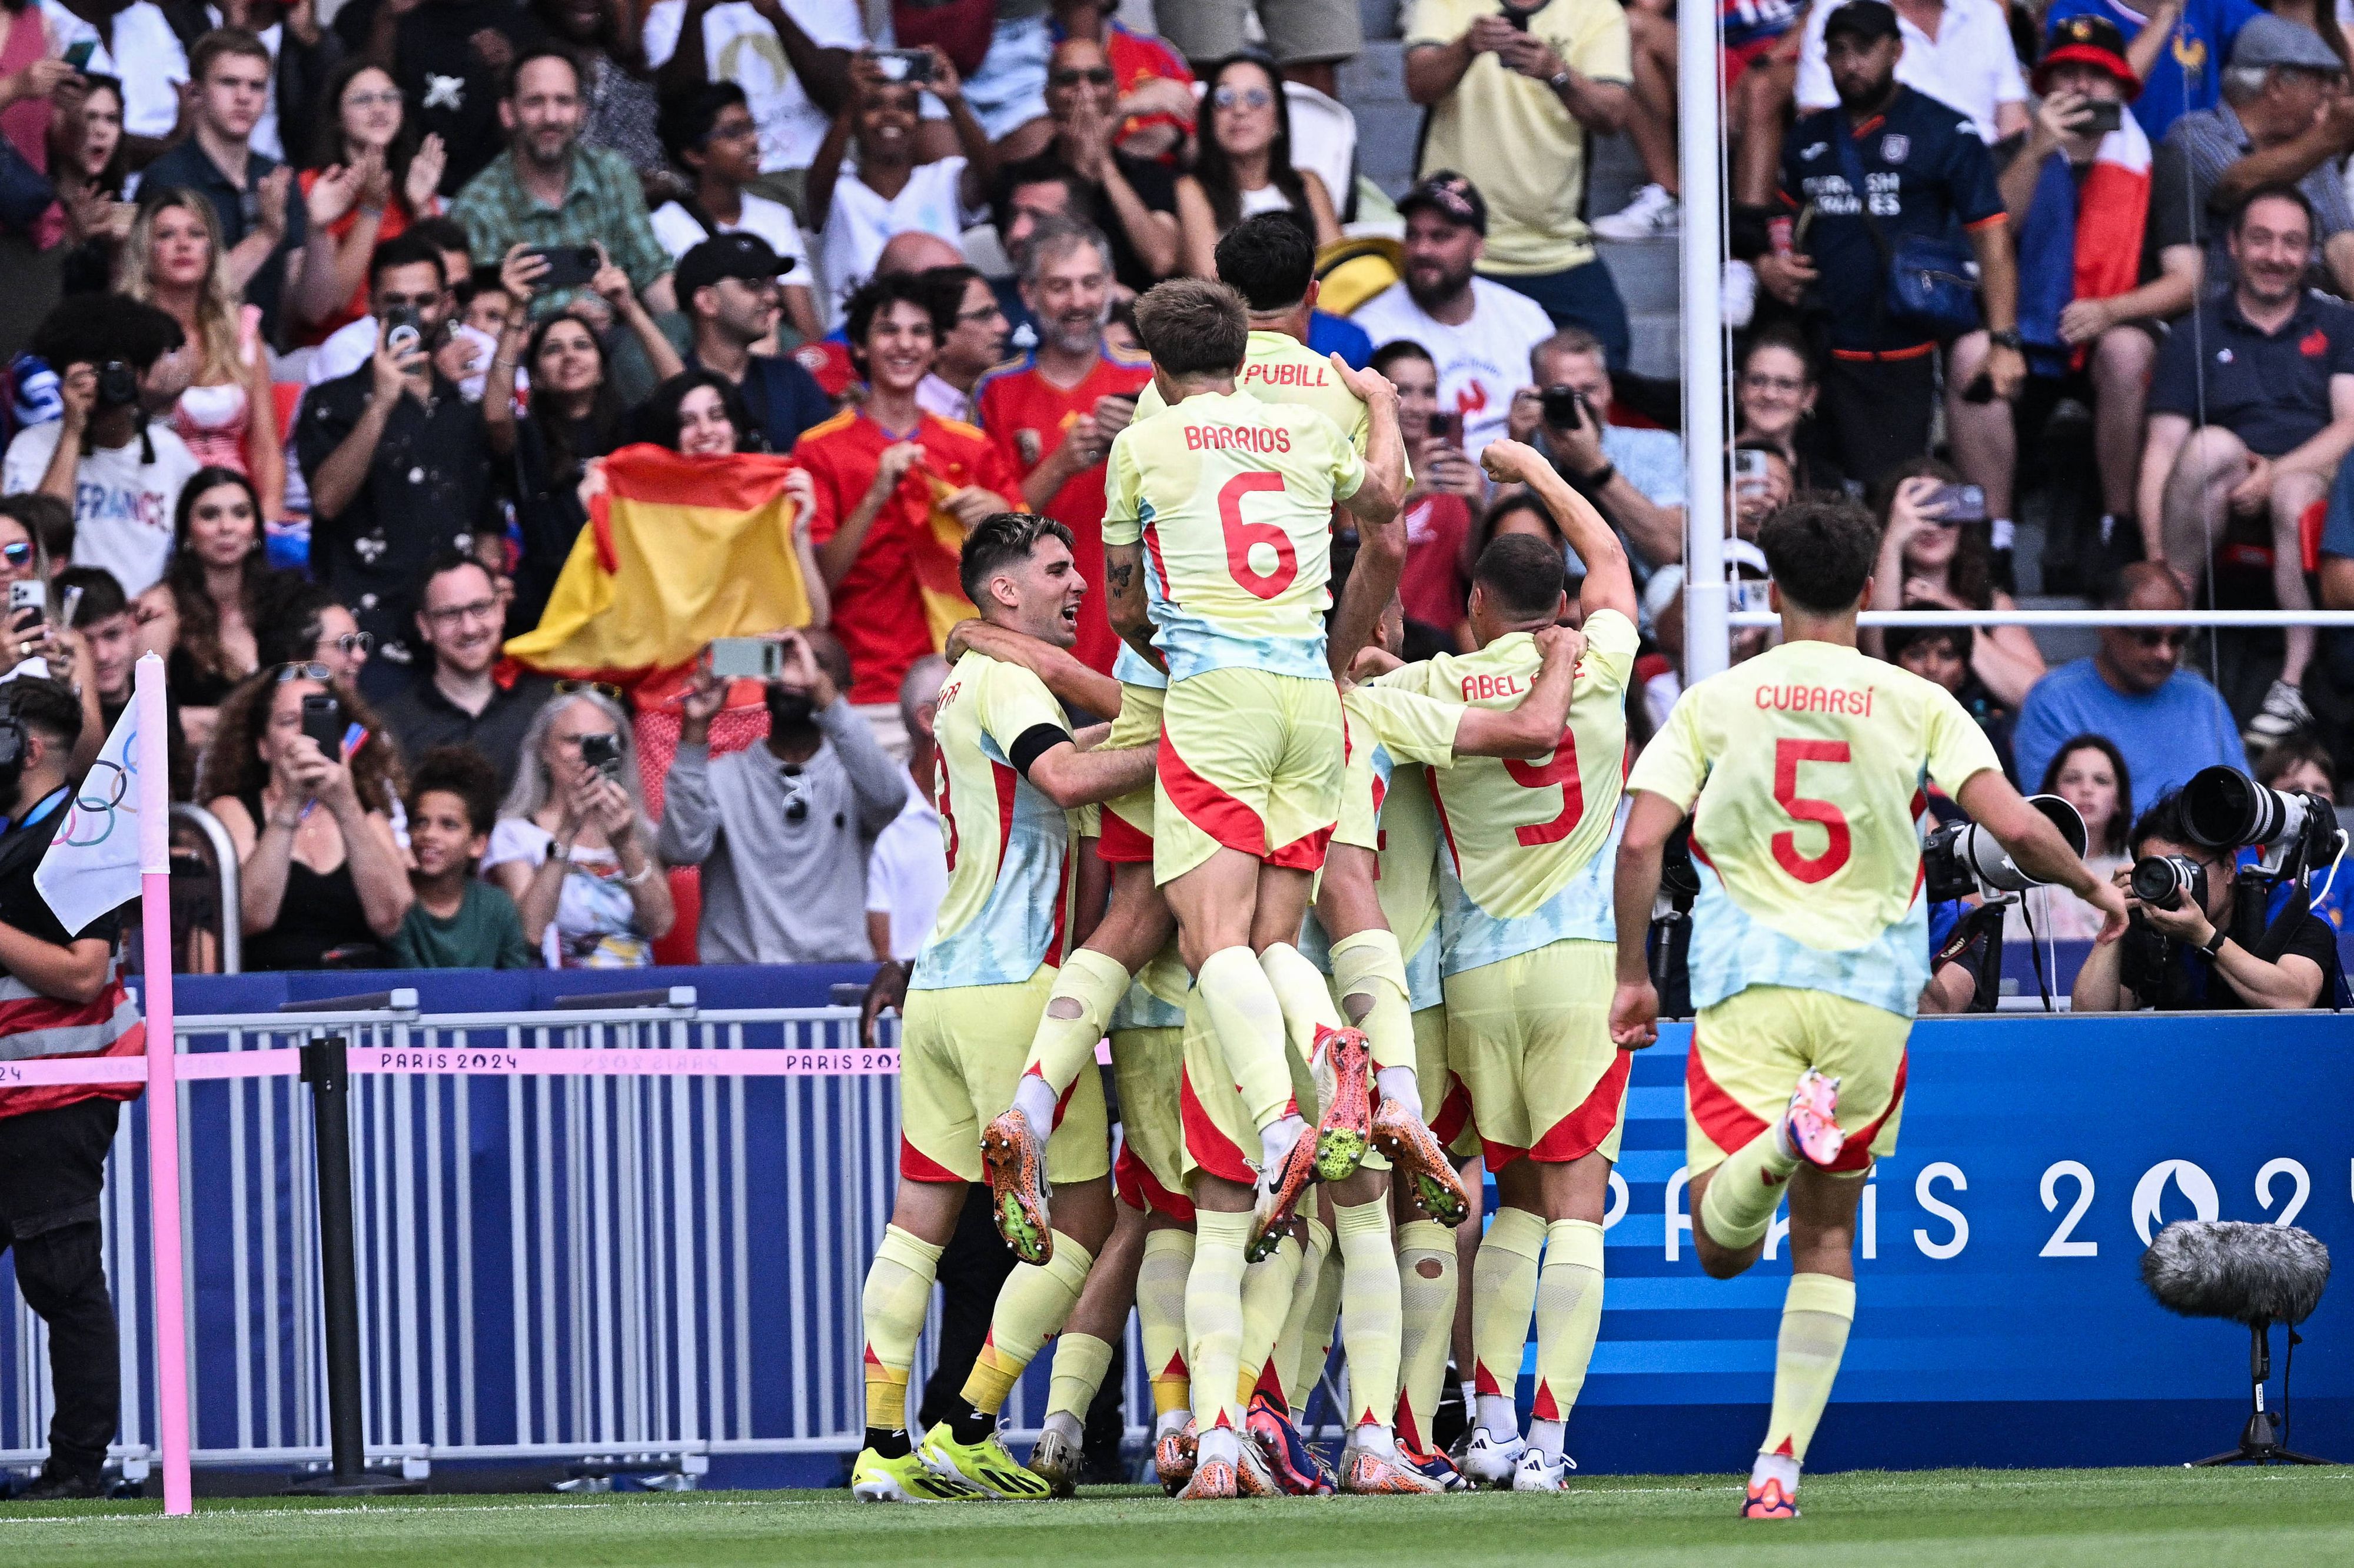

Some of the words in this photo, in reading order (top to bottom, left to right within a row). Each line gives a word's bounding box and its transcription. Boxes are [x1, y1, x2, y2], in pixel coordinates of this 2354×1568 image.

[1244, 364, 1329, 387] PUBILL
[1184, 425, 1291, 453] BARRIOS
[1218, 471, 1298, 600] 6
[1461, 674, 1524, 703] ABEL
[1755, 685, 1874, 717] CUBARSÍ
[1501, 723, 1584, 847] 9
[1771, 737, 1852, 884] 5
[1940, 937, 1966, 958] Canon
[457, 1054, 516, 1068] 2024
[862, 1054, 900, 1069] 20
[2038, 1157, 2354, 1257] 202
